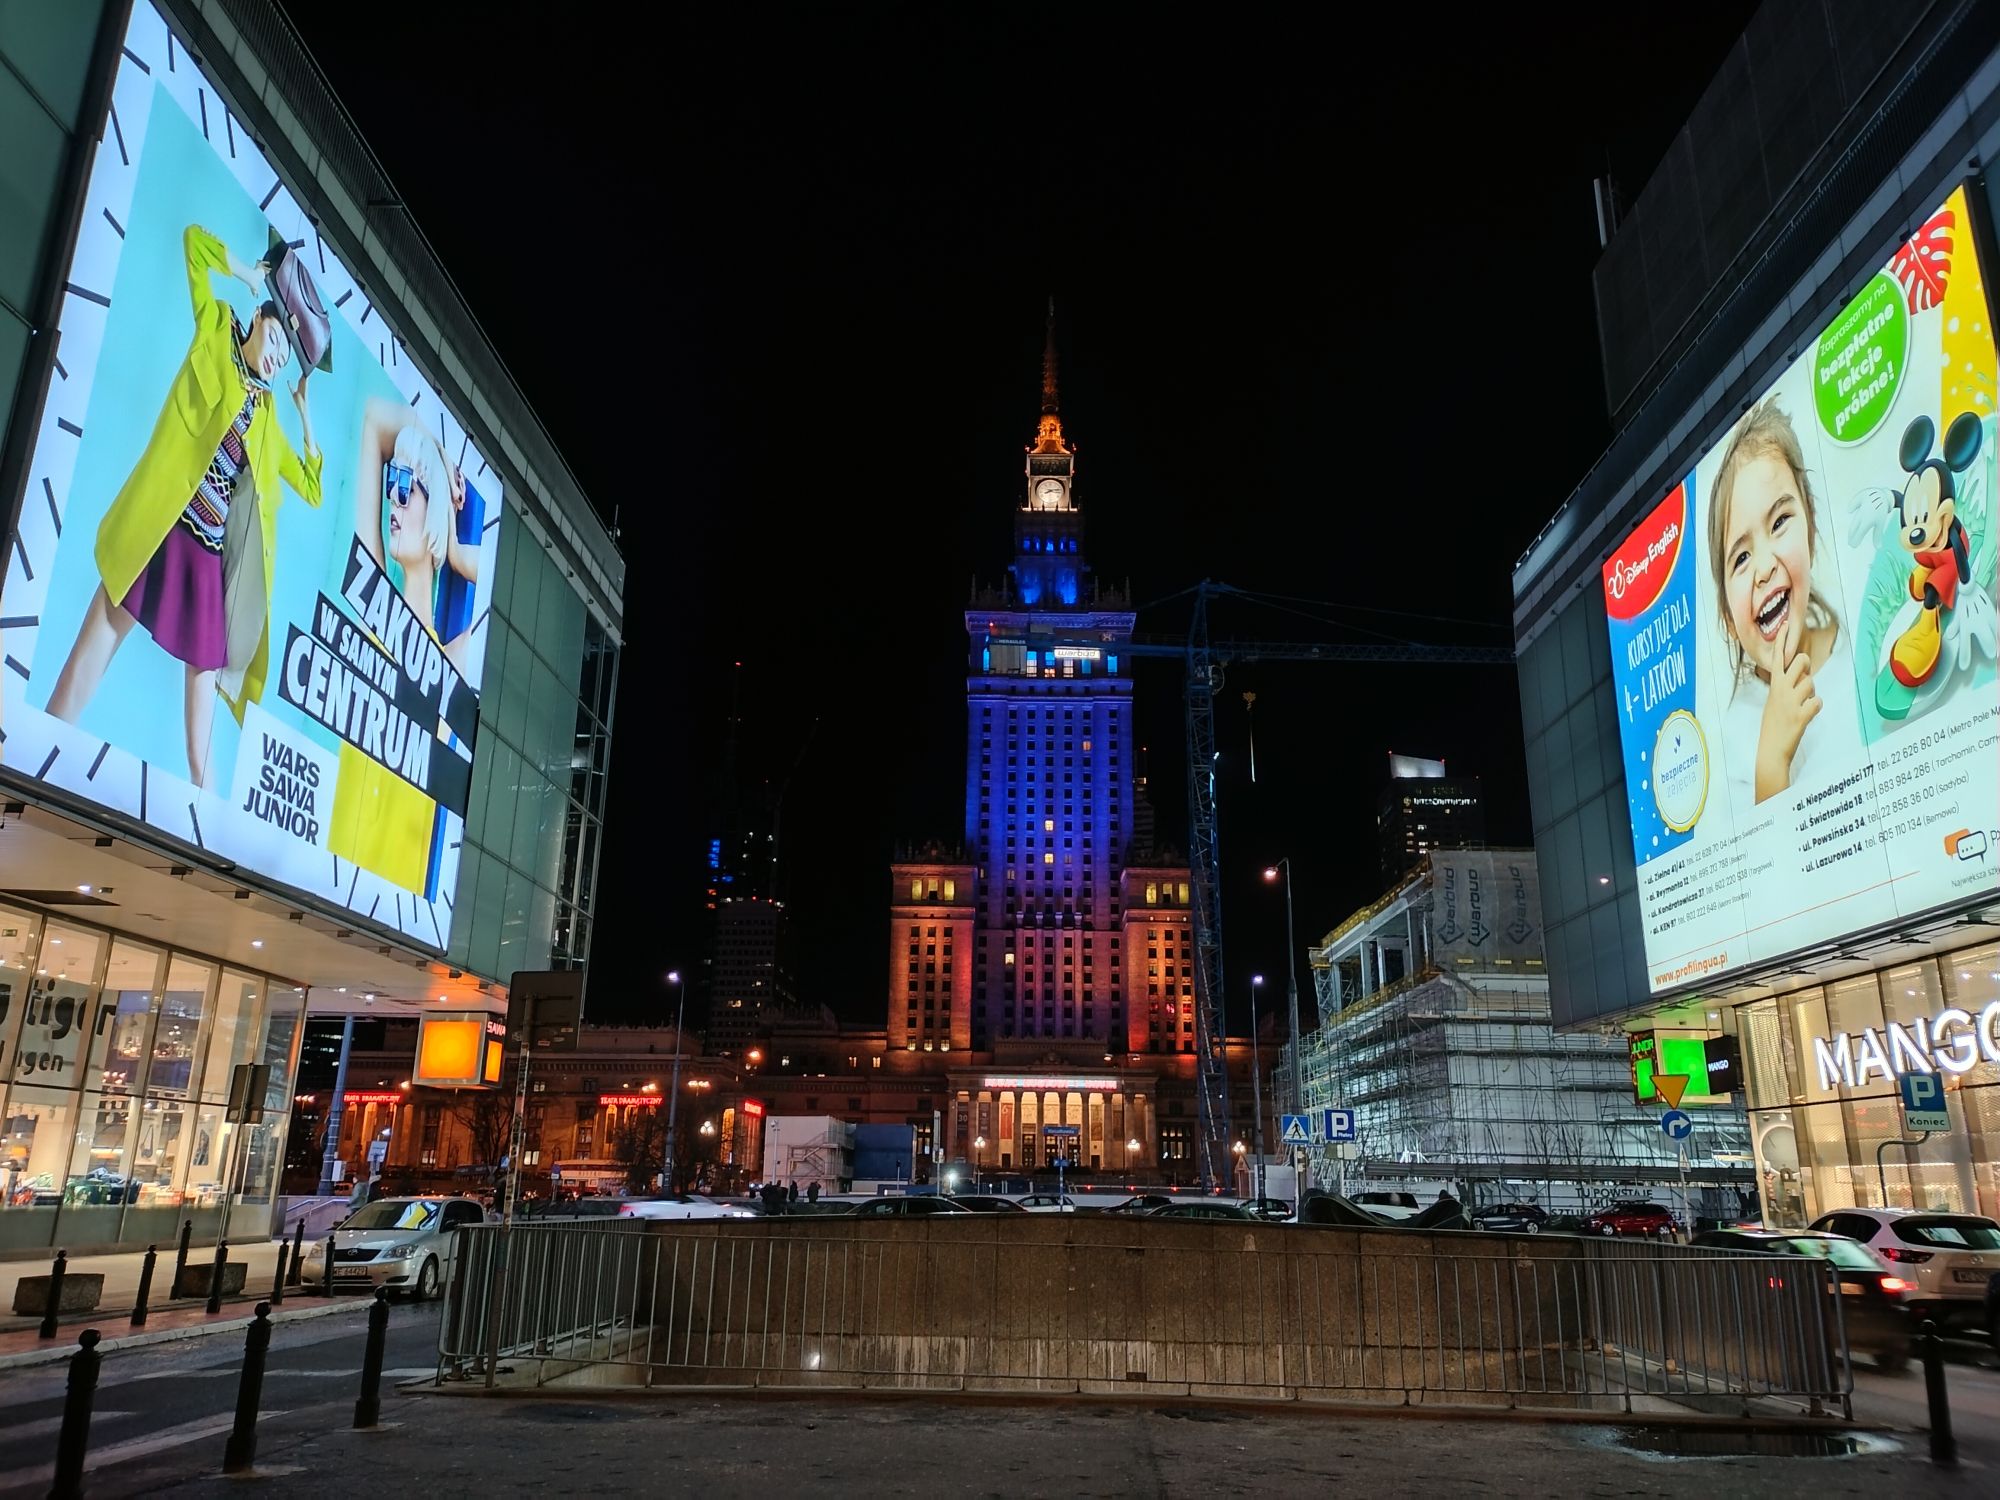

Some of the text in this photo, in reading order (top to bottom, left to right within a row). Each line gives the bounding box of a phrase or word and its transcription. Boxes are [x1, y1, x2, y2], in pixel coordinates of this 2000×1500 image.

[1874, 282, 1887, 301] na
[1820, 304, 1894, 385] bezpłatne
[1838, 346, 1883, 397] lekcje
[1835, 360, 1895, 435] próbne!
[1624, 523, 1679, 585] Disney English
[320, 602, 399, 700] W SAMYM
[345, 544, 459, 718] ZAKUPY
[1627, 593, 1690, 671] KURSY JUŻ DLA
[1641, 642, 1687, 712] LATKÓW
[286, 635, 432, 790] CENTRUM
[259, 764, 316, 816] SAWA
[262, 732, 320, 788] WARS
[1661, 753, 1698, 783] bezpieczne
[1796, 800, 1805, 811] al.
[1806, 769, 1862, 806] Niepodległości
[1891, 751, 1901, 764] 22
[1902, 743, 1918, 759] 626
[1920, 736, 1932, 750] 80
[1933, 729, 1946, 743] 04
[1973, 711, 1989, 726] Pole
[243, 787, 319, 846] JUNIOR
[1799, 820, 1808, 831] ul.
[1809, 801, 1853, 827] Światowida
[1878, 778, 1894, 794] 883
[1896, 770, 1912, 787] 984
[1913, 762, 1930, 778] 286
[1802, 840, 1811, 852] ul.
[1812, 826, 1853, 848] Powsińska
[1881, 805, 1891, 818] 22
[1892, 797, 1908, 813] 858
[1910, 791, 1921, 805] 36
[1922, 786, 1934, 799] 00
[1936, 770, 1969, 795] (Sadyba)
[1806, 860, 1815, 872] ul.
[1816, 847, 1853, 868] Lazurowa
[1878, 828, 1894, 843] 605
[1895, 823, 1906, 836] 110
[1907, 816, 1922, 831] 134
[1923, 801, 1960, 826] (Bemowo)
[1655, 951, 1729, 985] www.profilingua.pl
[1707, 1060, 1729, 1072] MANGO
[1908, 1116, 1945, 1126] Koniec
